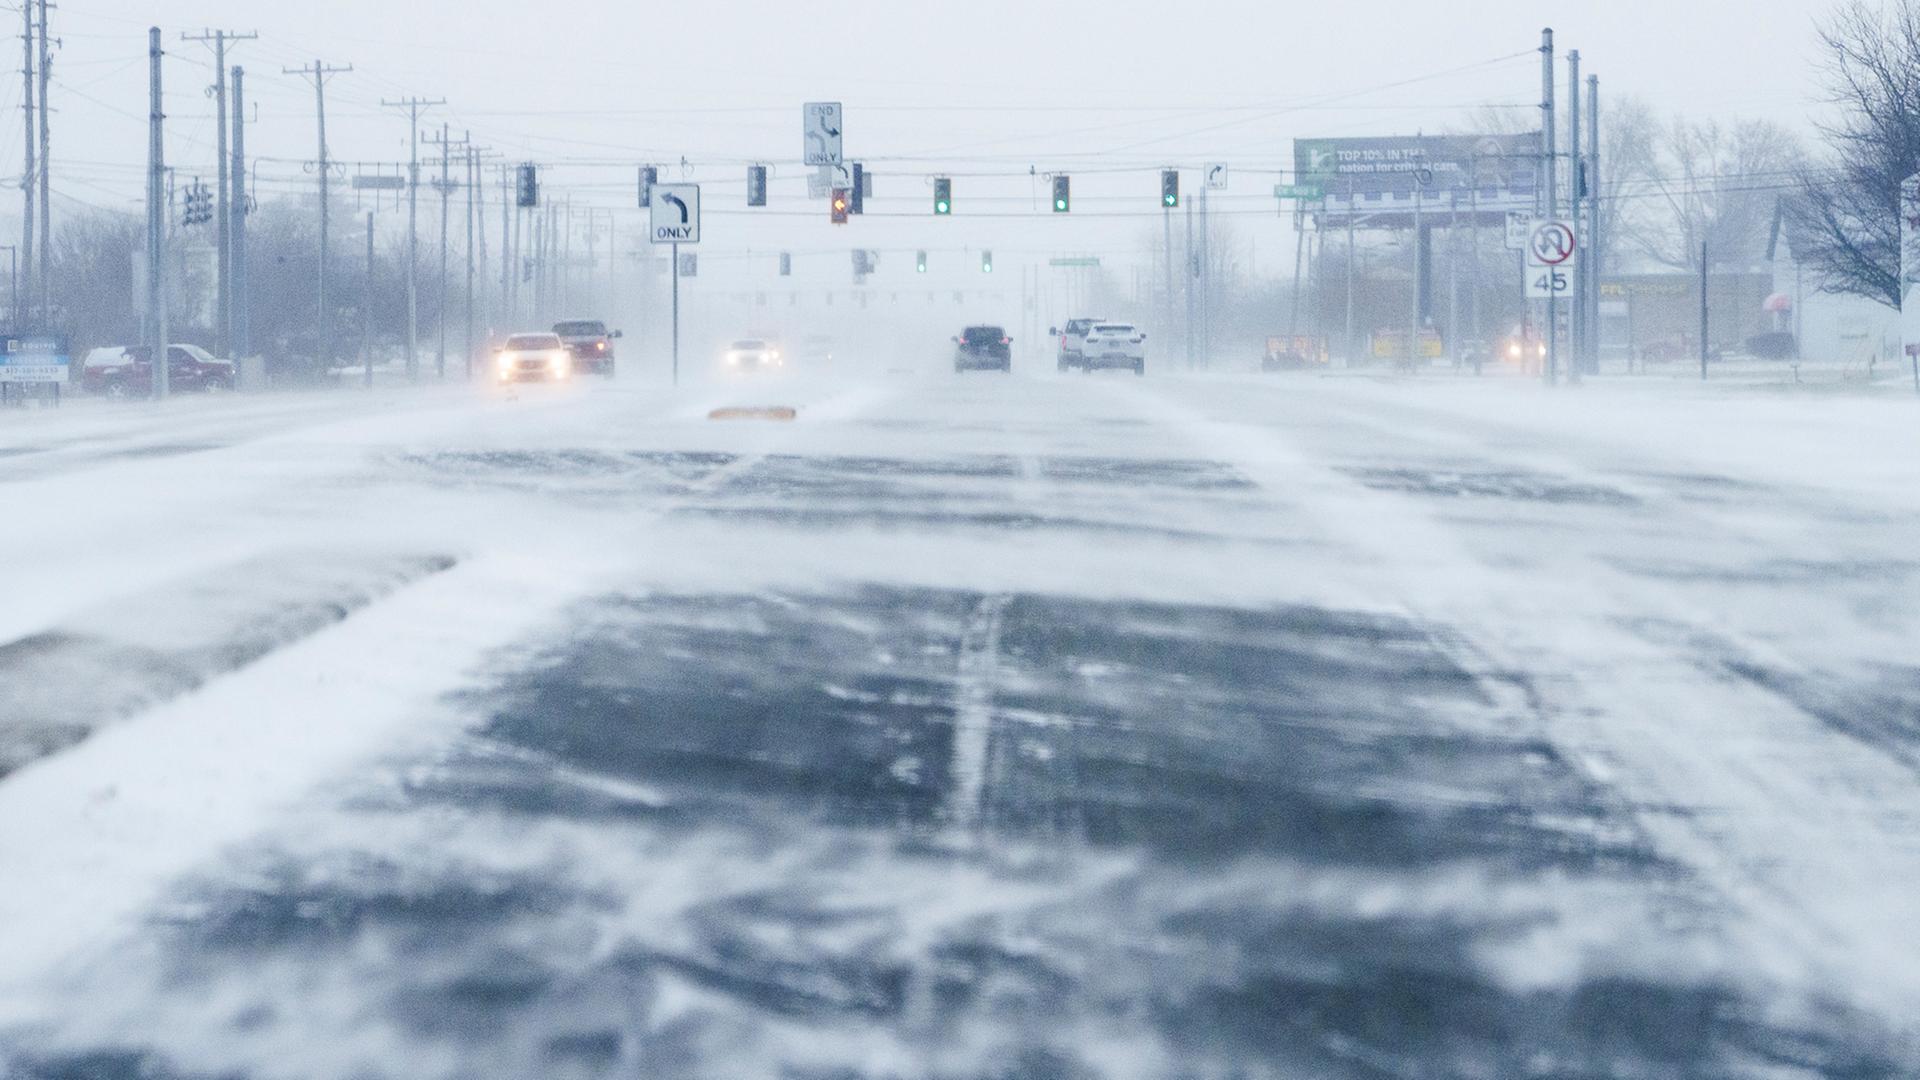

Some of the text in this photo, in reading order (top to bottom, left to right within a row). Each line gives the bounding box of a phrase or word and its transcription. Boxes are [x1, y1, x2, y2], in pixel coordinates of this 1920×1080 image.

[811, 105, 834, 116] END
[809, 153, 837, 163] ONLY
[1338, 151, 1360, 161] TOP
[1387, 150, 1400, 160] IN
[1338, 161, 1457, 173] nation for critial care
[657, 227, 692, 240] ONLY
[1534, 272, 1567, 291] 45
